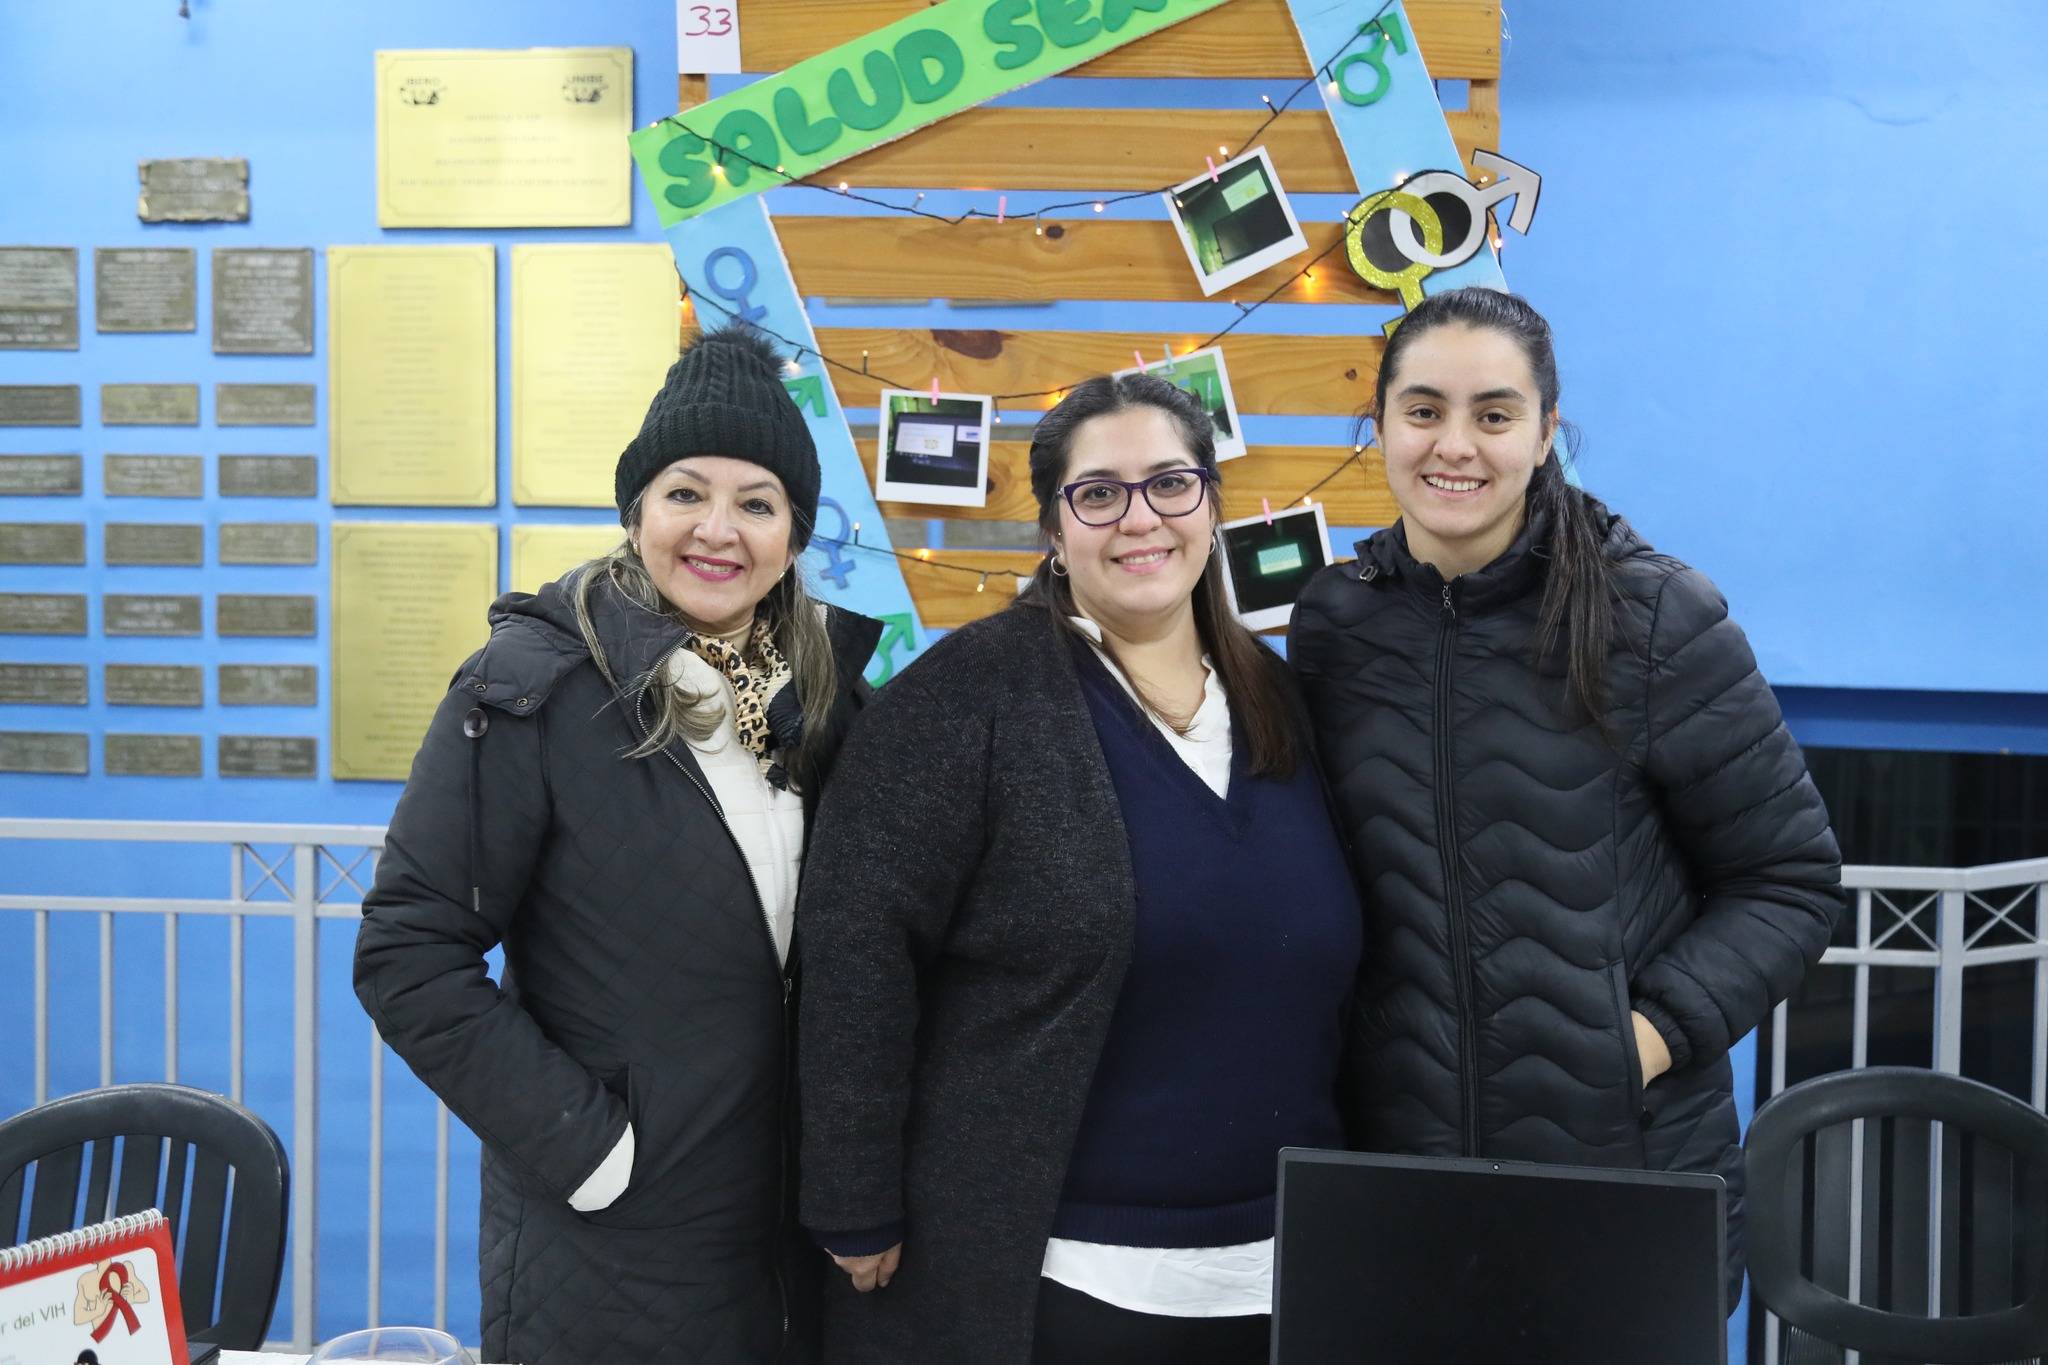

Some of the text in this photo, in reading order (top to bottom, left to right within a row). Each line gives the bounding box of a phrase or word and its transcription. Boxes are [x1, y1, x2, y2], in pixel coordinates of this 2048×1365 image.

[685, 5, 732, 36] 33
[658, 28, 965, 209] SALUD
[14, 1312, 35, 1331] del
[40, 1302, 66, 1321] VIH
